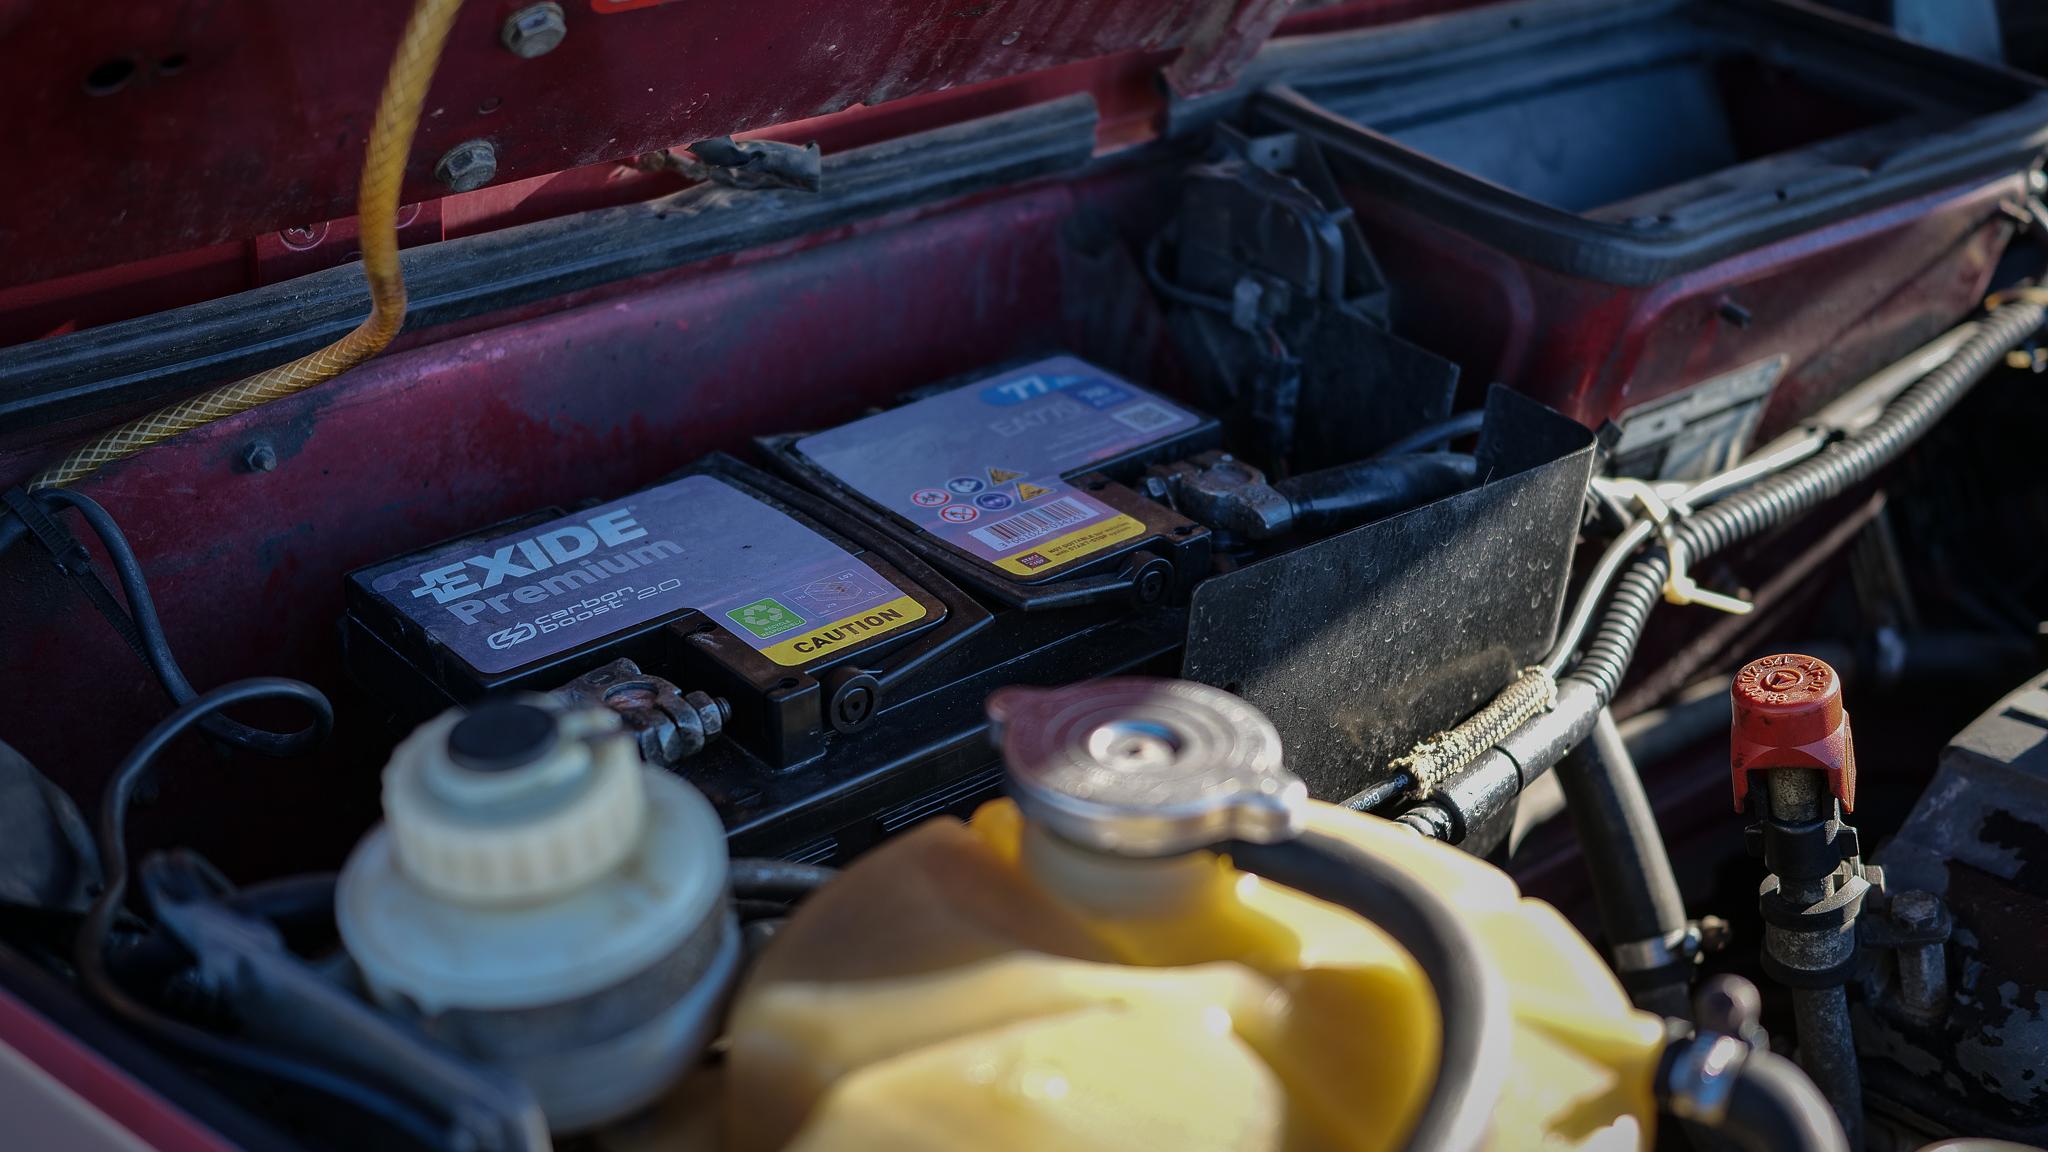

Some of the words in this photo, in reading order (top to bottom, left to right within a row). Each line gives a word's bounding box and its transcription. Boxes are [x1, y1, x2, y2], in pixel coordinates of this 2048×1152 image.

[997, 374, 1048, 400] 77
[411, 508, 648, 604] EXIDE
[447, 539, 685, 626] Premium
[534, 585, 635, 625] carbon
[637, 578, 681, 601] 2.0
[540, 600, 624, 634] boost
[793, 608, 904, 653] CAUTION
